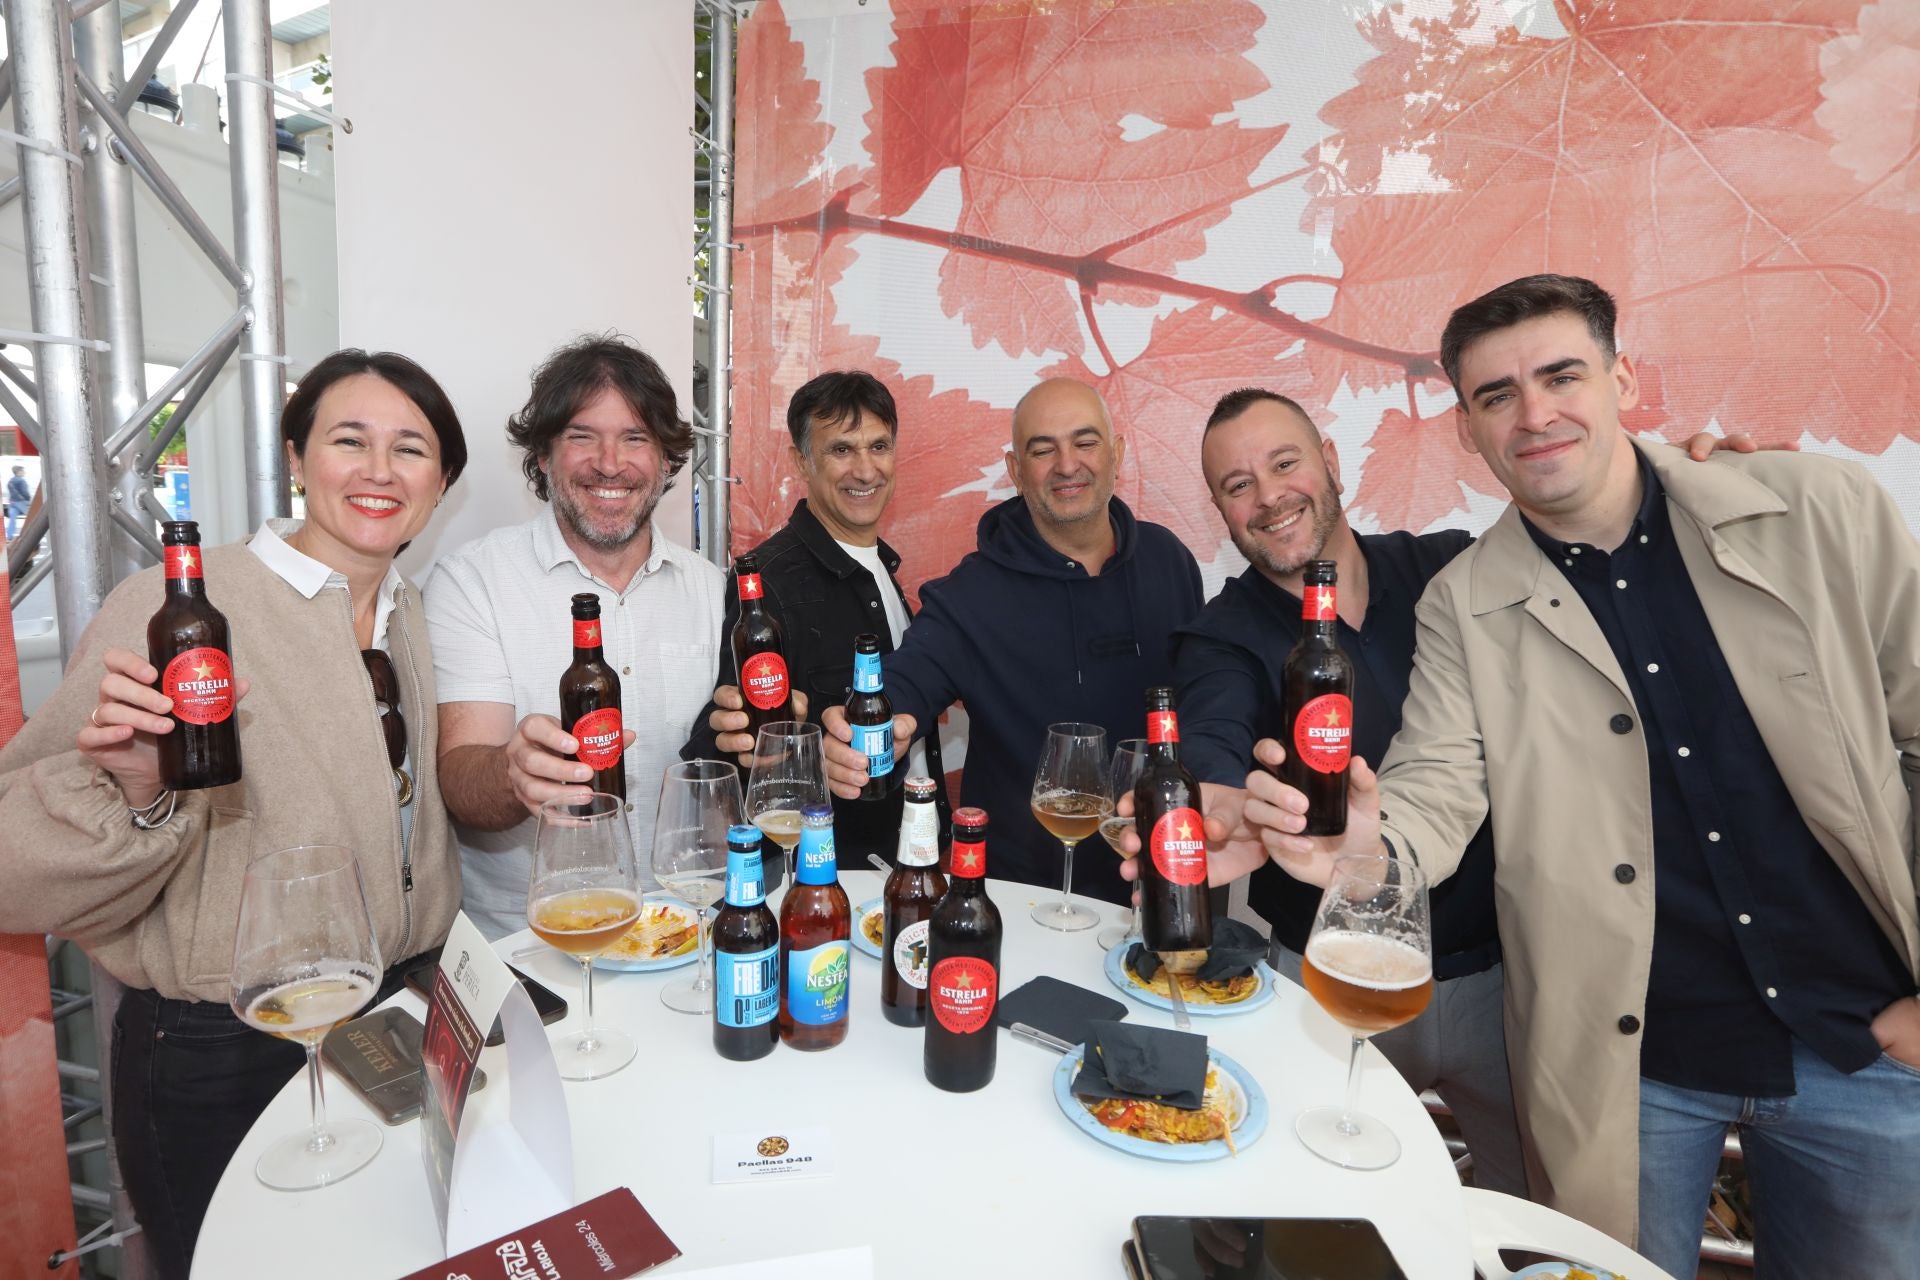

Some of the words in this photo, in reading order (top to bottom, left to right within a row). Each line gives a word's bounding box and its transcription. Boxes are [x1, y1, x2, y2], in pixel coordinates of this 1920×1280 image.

[178, 678, 229, 692] ESTRELLA
[749, 673, 783, 686] ESTRELLA
[583, 730, 620, 744] ESTRELLA
[1308, 727, 1350, 738] ESTRELLA
[1164, 840, 1204, 851] ESTRELLA
[903, 927, 929, 945] VICT
[806, 969, 848, 988] NESTEA
[940, 985, 988, 1000] ESTRELLA
[347, 1030, 392, 1073] KELER
[738, 1159, 783, 1167] Paellas
[575, 1219, 592, 1233] 24
[585, 1231, 617, 1272] Miércoles
